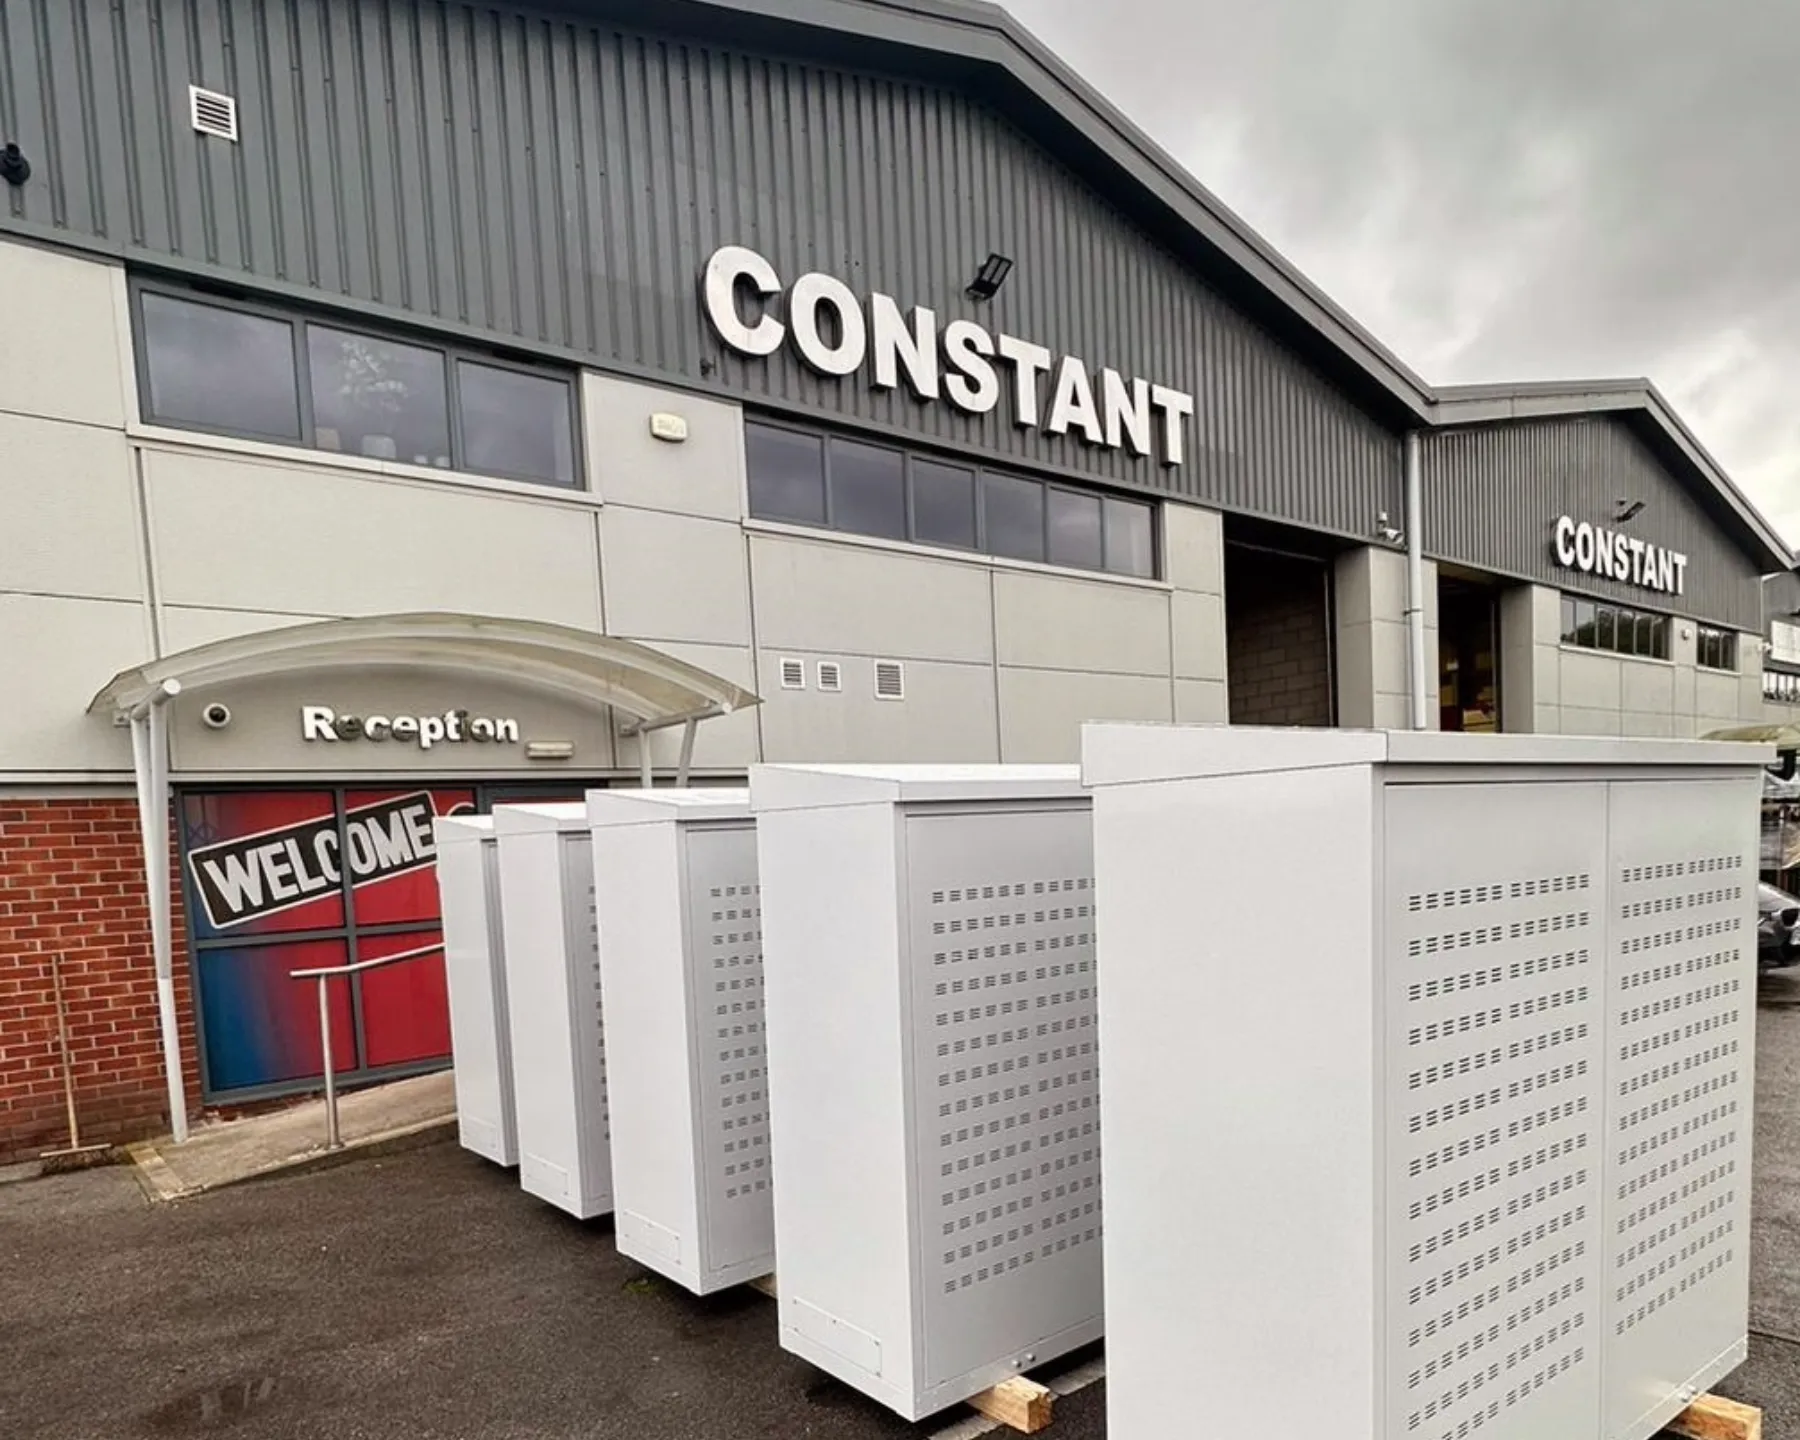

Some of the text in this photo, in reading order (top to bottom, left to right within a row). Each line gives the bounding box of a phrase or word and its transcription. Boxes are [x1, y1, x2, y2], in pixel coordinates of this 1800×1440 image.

[704, 245, 1194, 466] CONSTANT
[1556, 514, 1687, 594] CONSTANT
[302, 706, 519, 748] Reception
[202, 804, 437, 913] WELCOME
